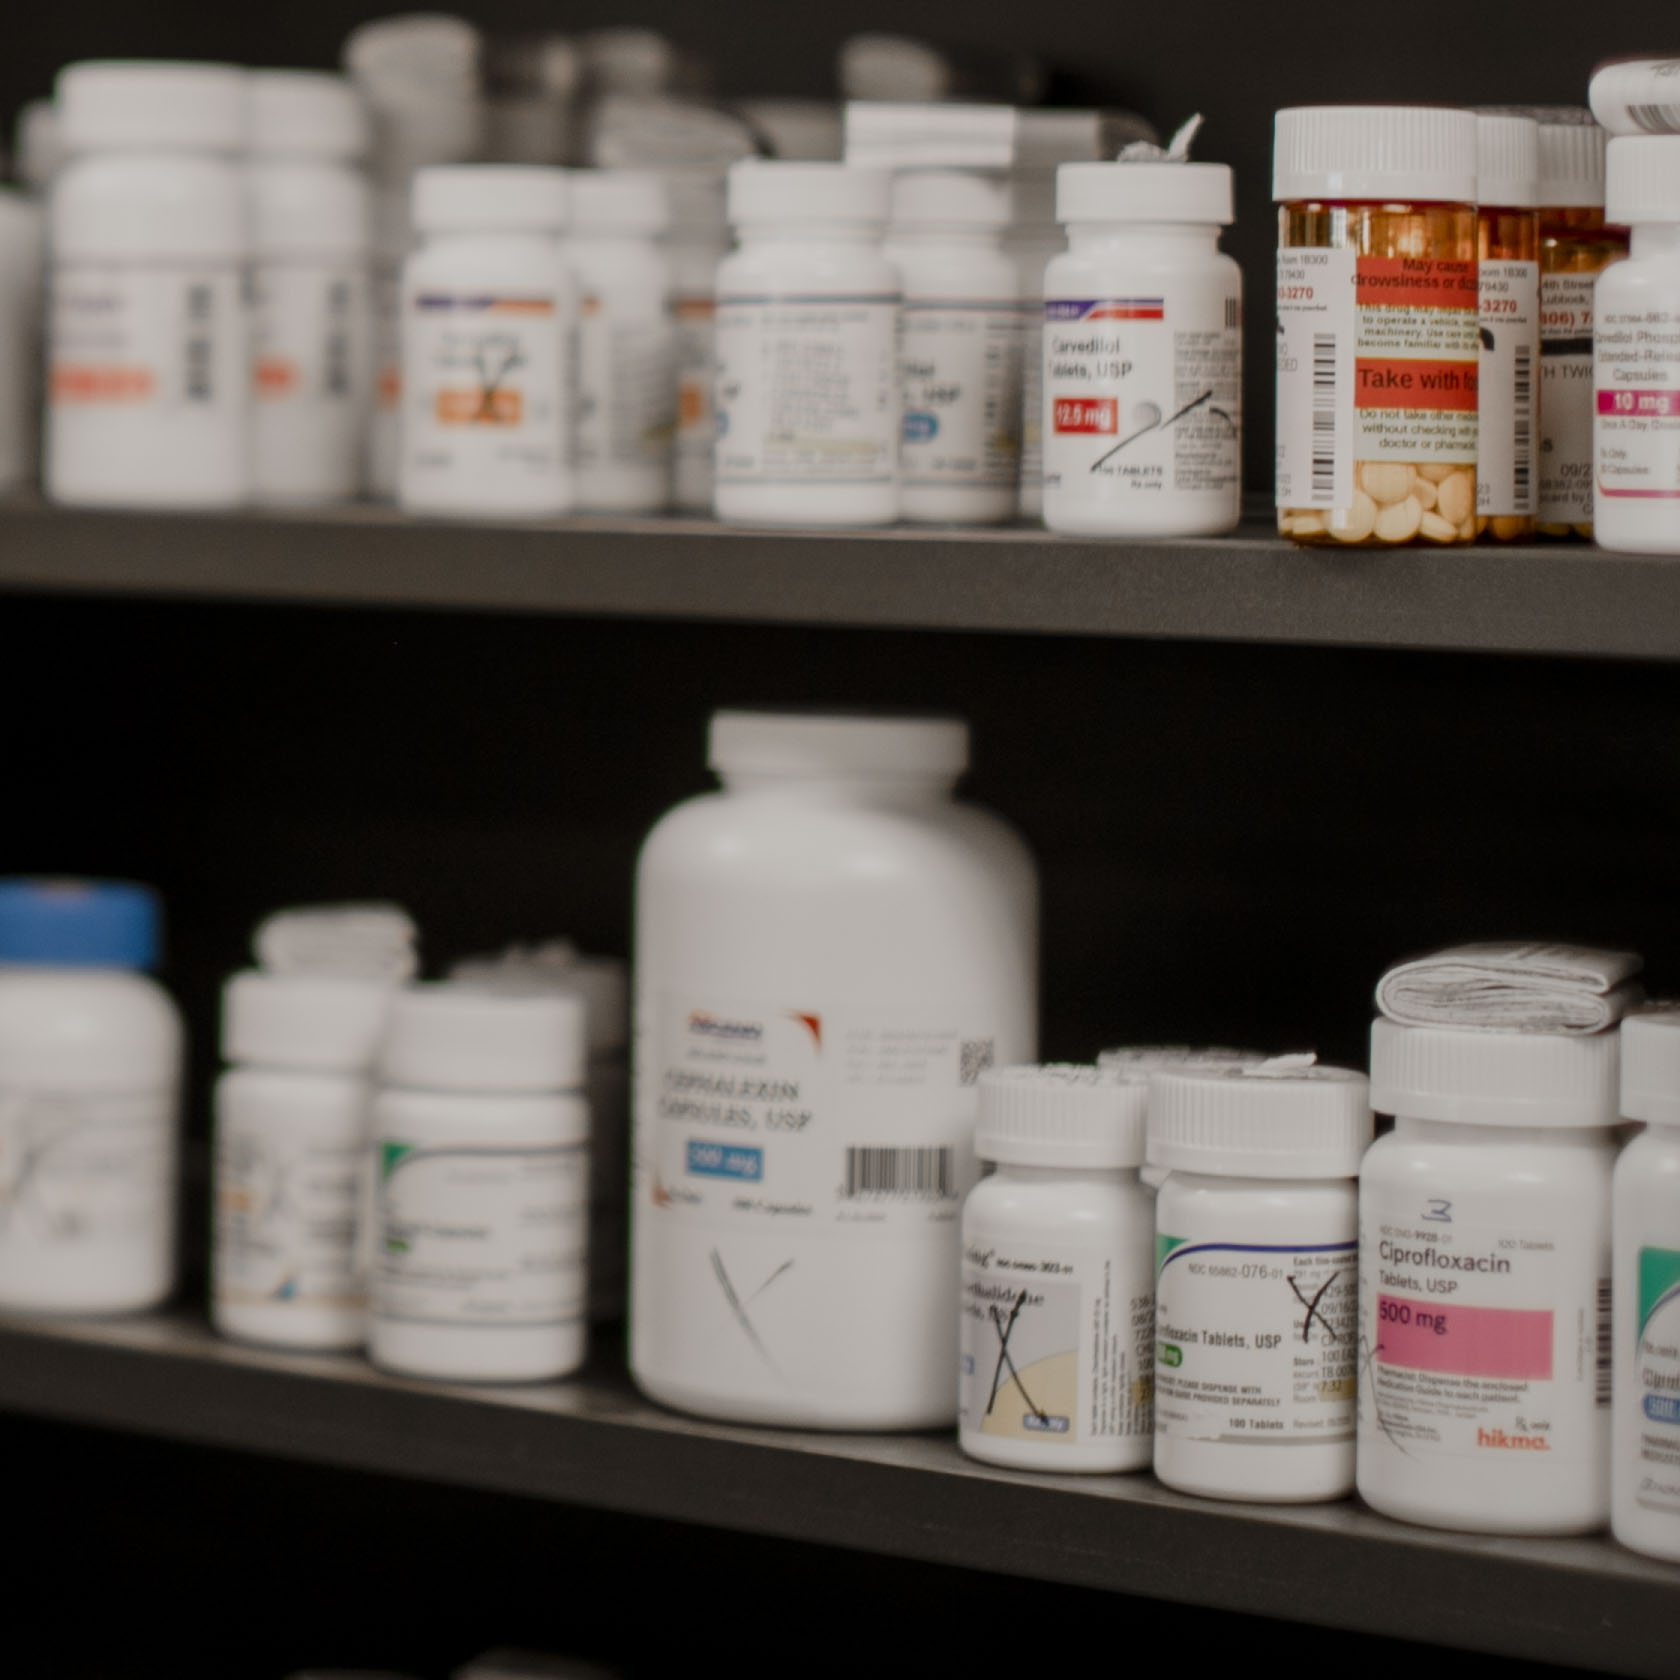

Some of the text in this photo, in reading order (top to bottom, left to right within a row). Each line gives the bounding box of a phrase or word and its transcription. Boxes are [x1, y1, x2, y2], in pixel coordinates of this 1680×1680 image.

[1402, 259, 1469, 274] May cause
[1479, 268, 1500, 279] oom
[1351, 274, 1456, 290] drowsiness or
[1480, 299, 1518, 314] -3270
[1362, 315, 1374, 325] to
[1376, 316, 1418, 328] operate
[1051, 335, 1120, 354] Carvedilol
[1357, 338, 1401, 349] become
[1635, 331, 1680, 345] Phosp
[1096, 359, 1133, 378] USP
[1612, 368, 1668, 382] Capsules
[1359, 367, 1413, 390] Take
[1420, 369, 1461, 392] with
[1613, 392, 1671, 414] 10 mg
[1085, 405, 1111, 429] mg
[1362, 423, 1408, 435] without
[1411, 424, 1456, 438] checking
[1379, 438, 1432, 450] doctor or
[1378, 1239, 1512, 1274] Ciprofloxacin
[1378, 1269, 1459, 1294] Tablets, USP
[1378, 1300, 1448, 1336] 500 mg
[1201, 1329, 1251, 1351] Tablets,
[1254, 1333, 1283, 1351] USP
[1462, 1378, 1480, 1390] the
[1454, 1389, 1480, 1400] each
[1228, 1417, 1284, 1431] 100 Tablets
